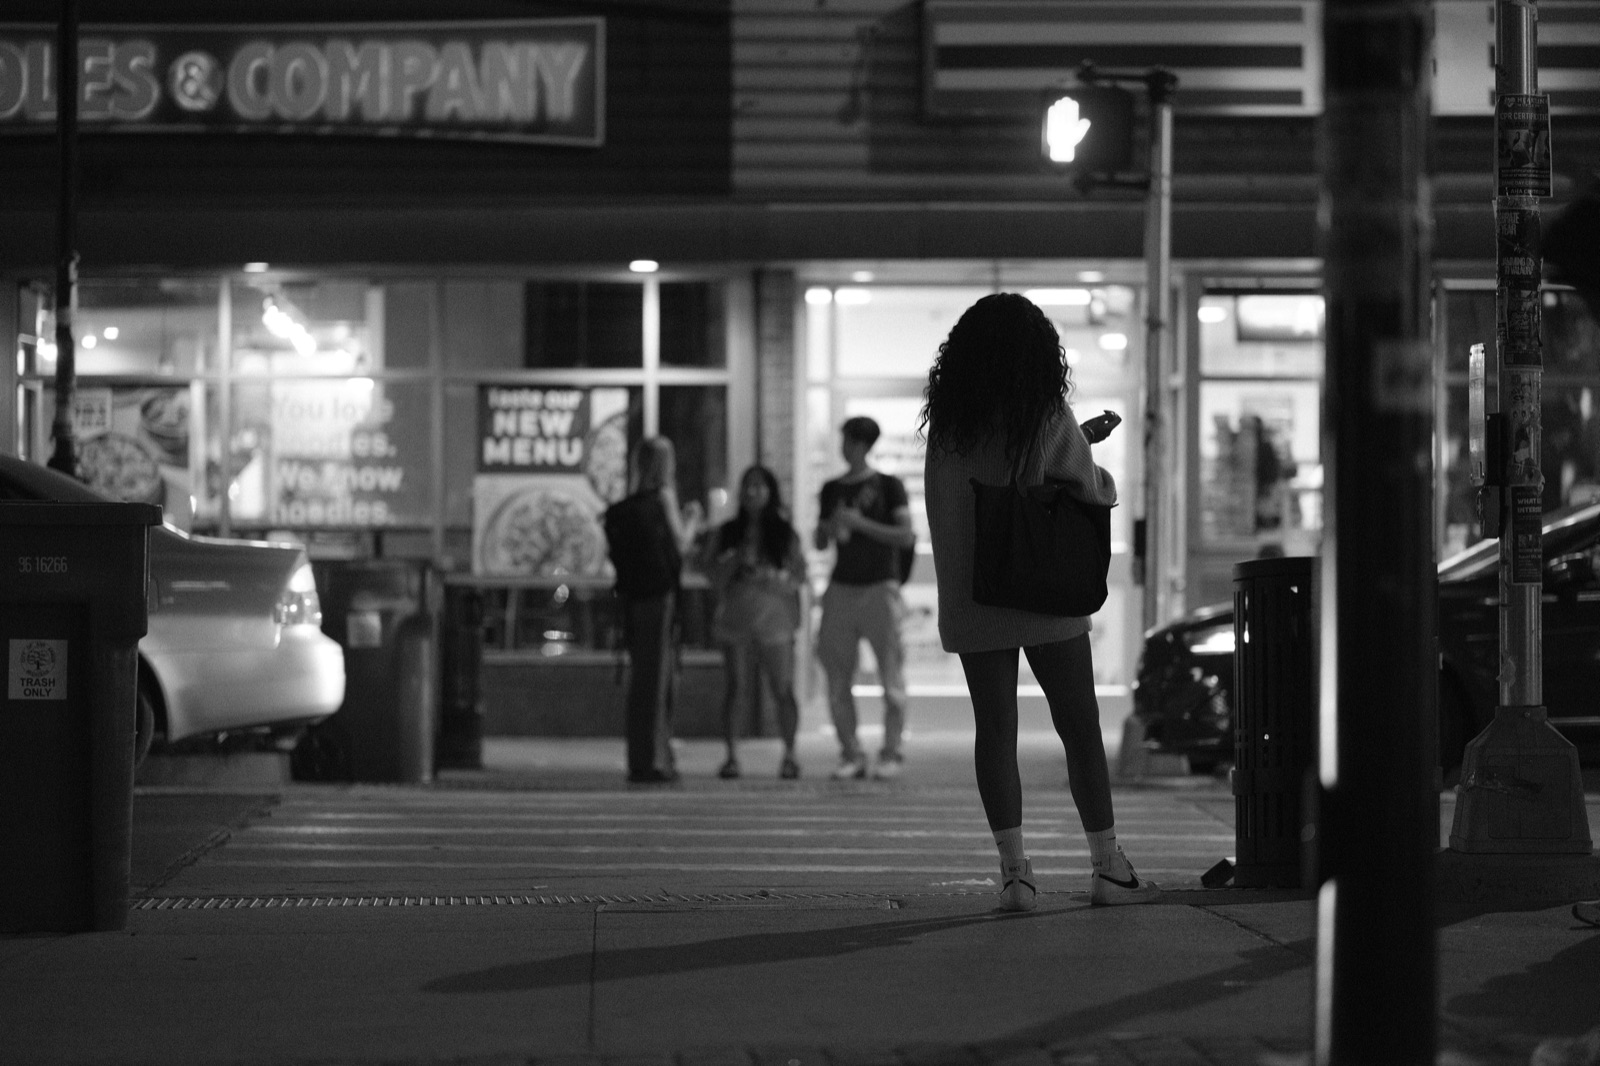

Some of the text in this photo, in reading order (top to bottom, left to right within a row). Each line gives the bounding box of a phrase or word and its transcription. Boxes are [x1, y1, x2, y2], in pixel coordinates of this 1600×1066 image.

[169, 52, 219, 110] &
[227, 38, 588, 123] COMPANY
[493, 410, 574, 437] NEW
[483, 436, 583, 466] MENU
[18, 556, 68, 573] 96 16266
[20, 677, 55, 687] TRASH
[23, 688, 51, 697] ONLY
